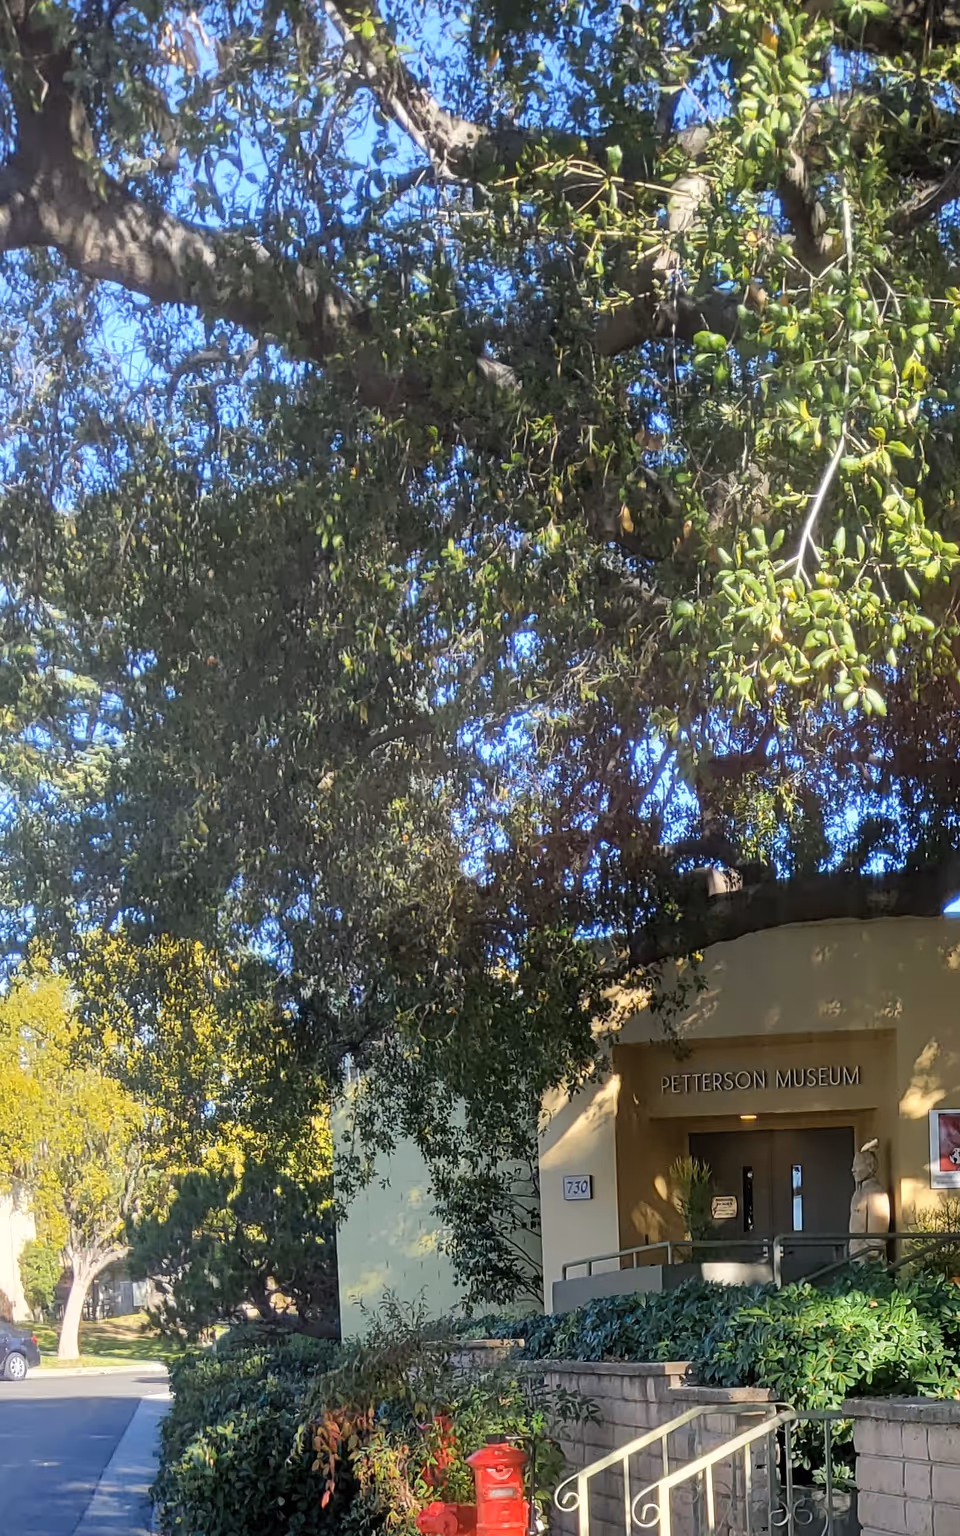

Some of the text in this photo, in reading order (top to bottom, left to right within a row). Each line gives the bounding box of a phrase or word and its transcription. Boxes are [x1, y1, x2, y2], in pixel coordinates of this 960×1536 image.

[661, 1065, 860, 1094] PETTERSON MUSEUM
[565, 1179, 588, 1196] 730
